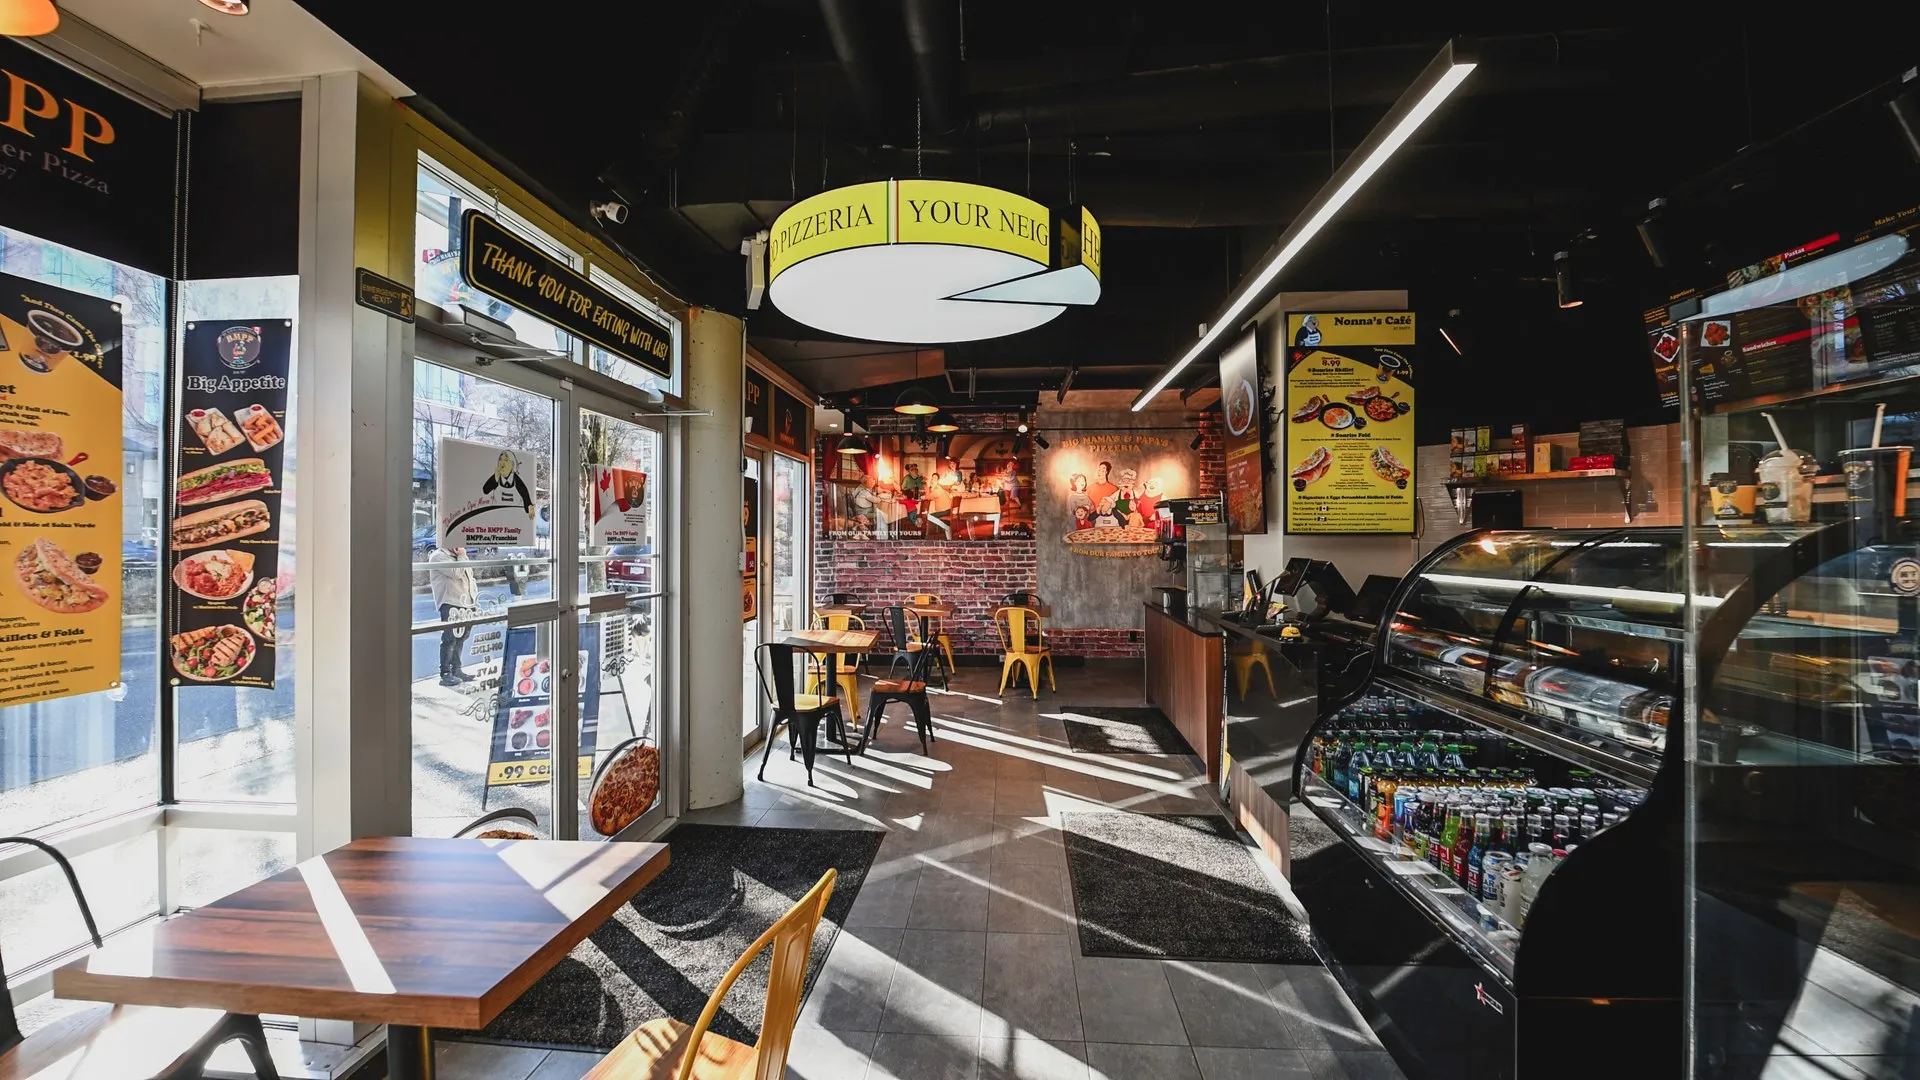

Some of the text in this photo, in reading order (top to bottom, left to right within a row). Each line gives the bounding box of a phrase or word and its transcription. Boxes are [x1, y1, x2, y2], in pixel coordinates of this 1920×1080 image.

[43, 151, 110, 195] Pizza
[1875, 208, 1916, 226] Make Your
[781, 202, 874, 254] PIZZERIA
[908, 200, 991, 229] YOUR
[999, 208, 1049, 247] NEIG
[1784, 248, 1805, 258] Pastas
[361, 282, 402, 299] EMERGENCY
[483, 242, 669, 361] THANK YOU FOR EATING WITH US!
[44, 302, 65, 317] Then
[65, 313, 86, 331] Came
[85, 328, 97, 343] The
[1334, 316, 1412, 326] Nonna's Café
[1742, 341, 1777, 353] Sandwiches
[187, 375, 285, 394] Big Appetite
[1063, 439, 1080, 449] BIG
[1083, 435, 1121, 444] MAMA'S
[1136, 436, 1169, 447] PAPA'S
[1090, 444, 1141, 453] PIZZERIA
[1092, 550, 1105, 558] OUR
[1105, 550, 1132, 558] FAMILY
[1132, 549, 1141, 557] TO
[40, 630, 51, 638] &
[54, 628, 85, 637] Folds
[498, 764, 525, 780] .99
